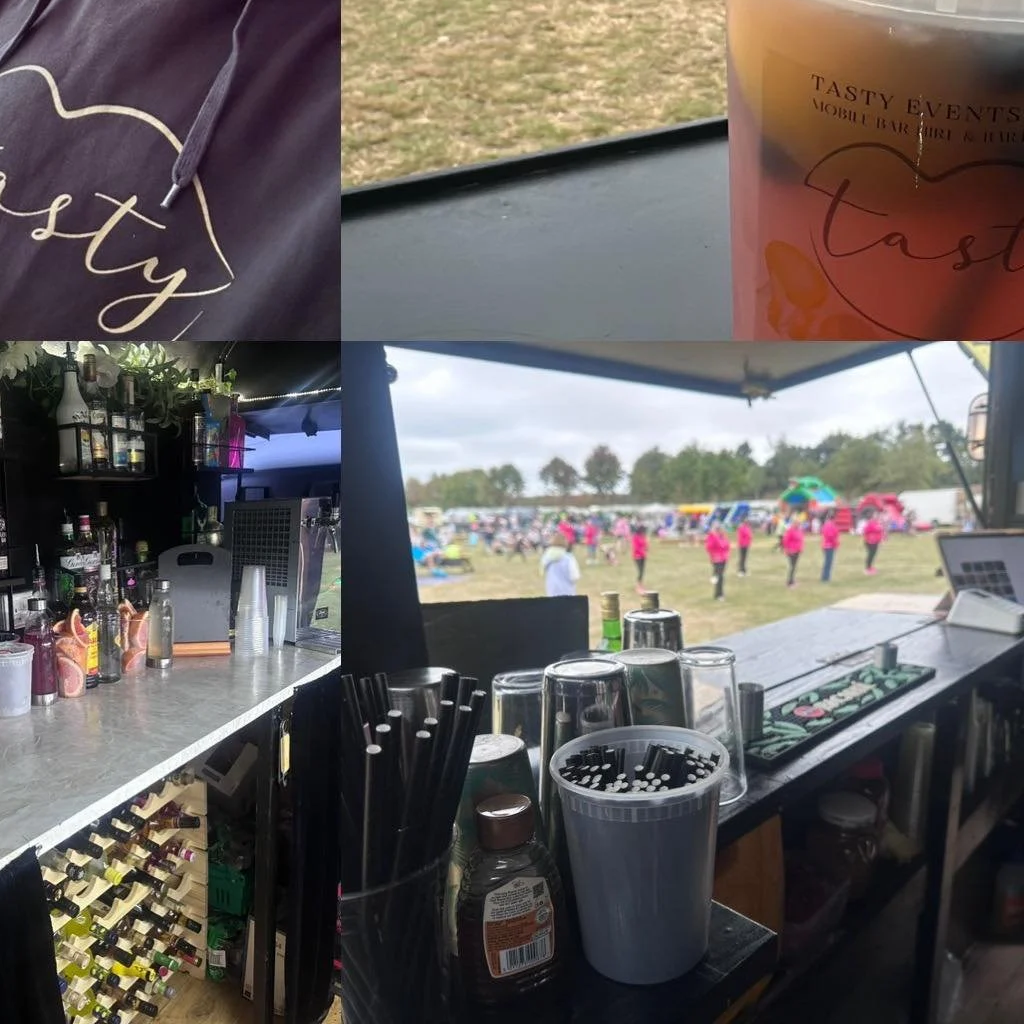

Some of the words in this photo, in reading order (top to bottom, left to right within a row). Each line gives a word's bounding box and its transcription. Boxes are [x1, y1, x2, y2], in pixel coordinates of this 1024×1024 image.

[811, 73, 895, 110] TASTY
[906, 97, 1022, 123] EVENTS
[812, 97, 869, 126] MOBILE
[876, 116, 909, 134] BAR
[916, 123, 952, 141] HIRE
